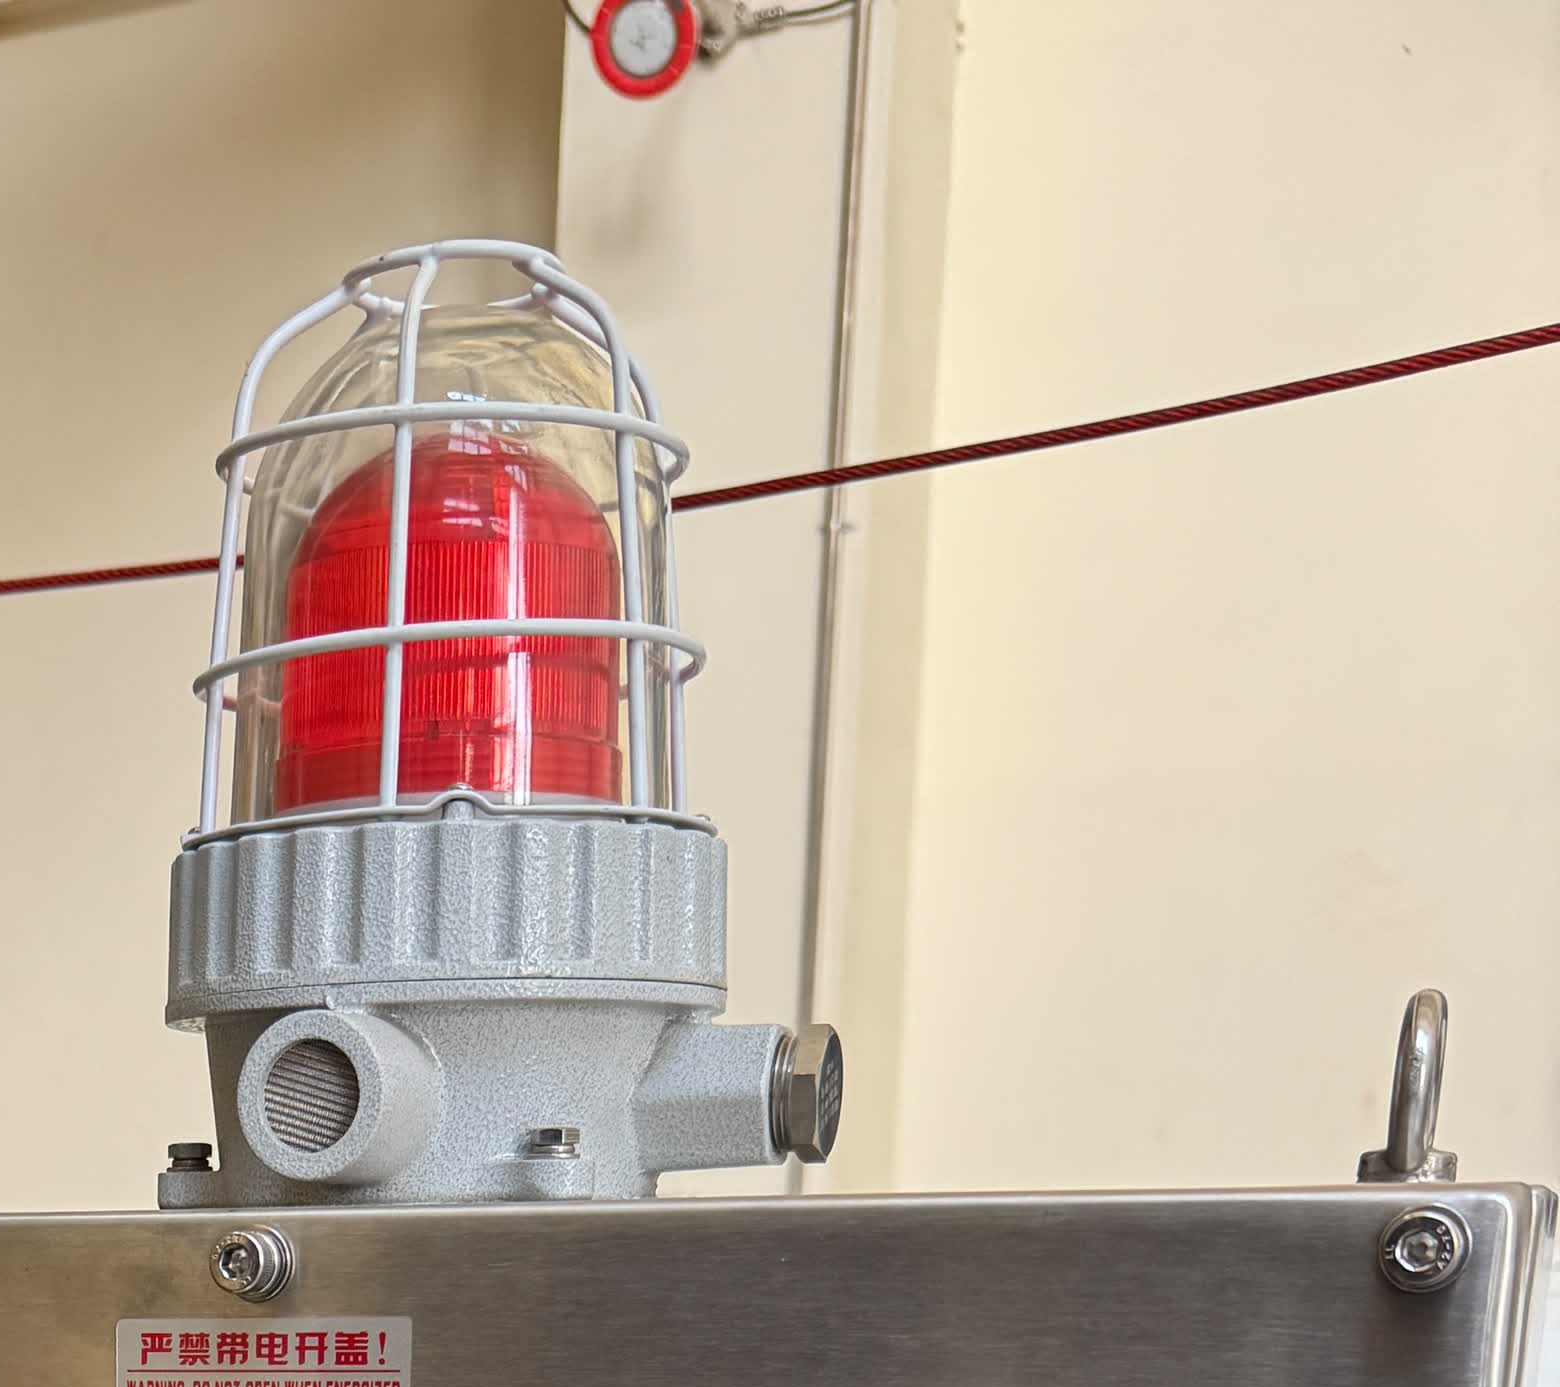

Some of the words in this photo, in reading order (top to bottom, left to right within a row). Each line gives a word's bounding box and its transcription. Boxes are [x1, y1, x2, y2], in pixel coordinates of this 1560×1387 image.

[140, 1331, 387, 1366] 严禁带电开盖!
